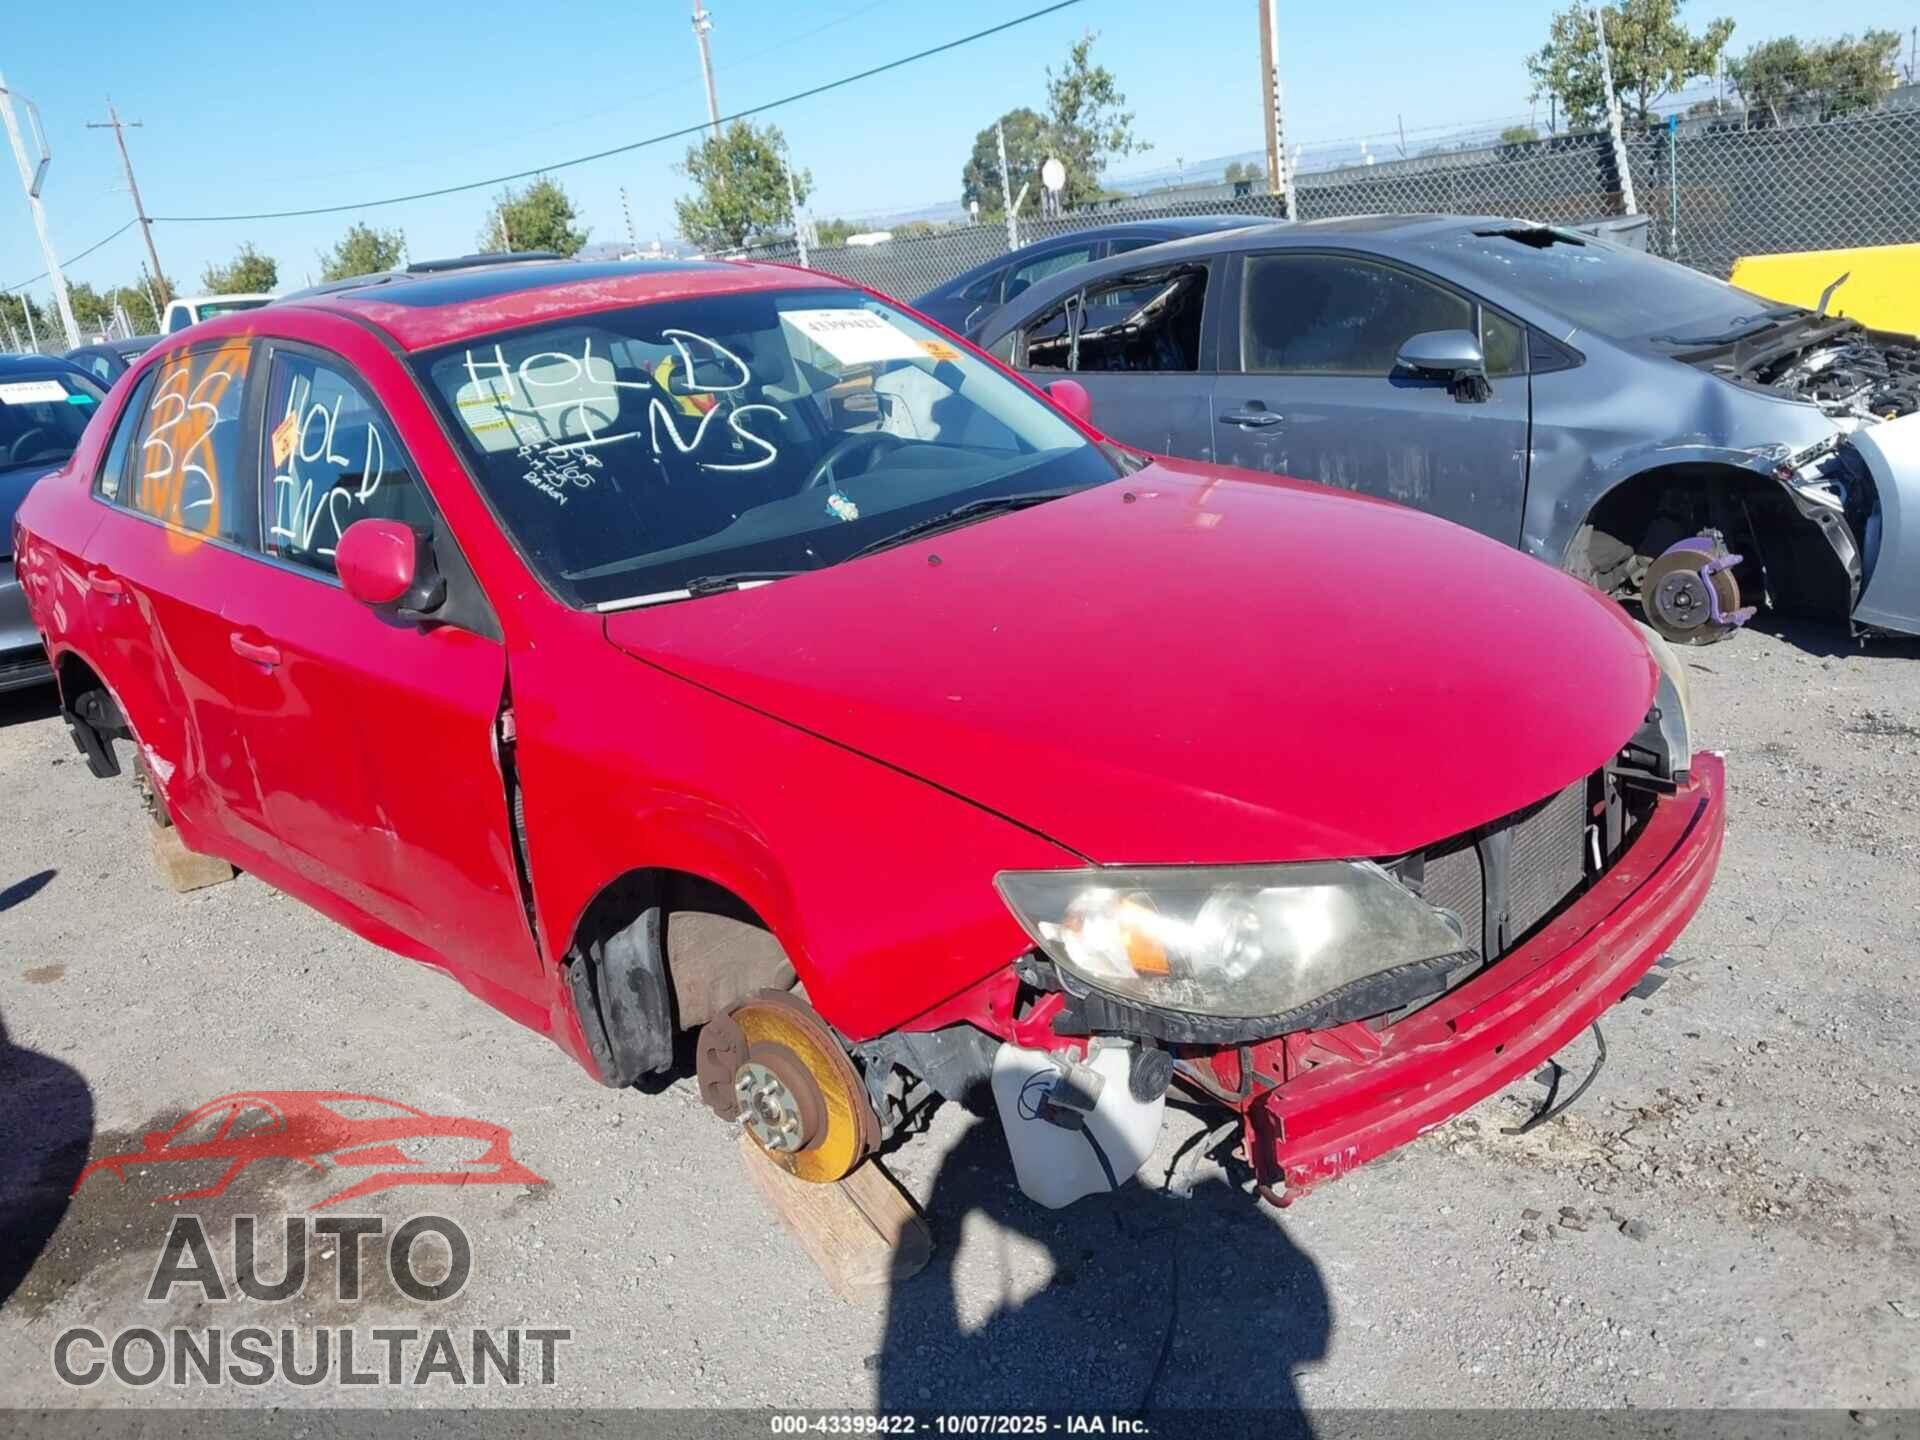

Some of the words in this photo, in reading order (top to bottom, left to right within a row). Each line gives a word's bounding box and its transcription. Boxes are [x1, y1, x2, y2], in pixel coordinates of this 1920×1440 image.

[462, 329, 751, 399] HOLD
[287, 375, 384, 504] HOLD
[524, 396, 788, 471] INS
